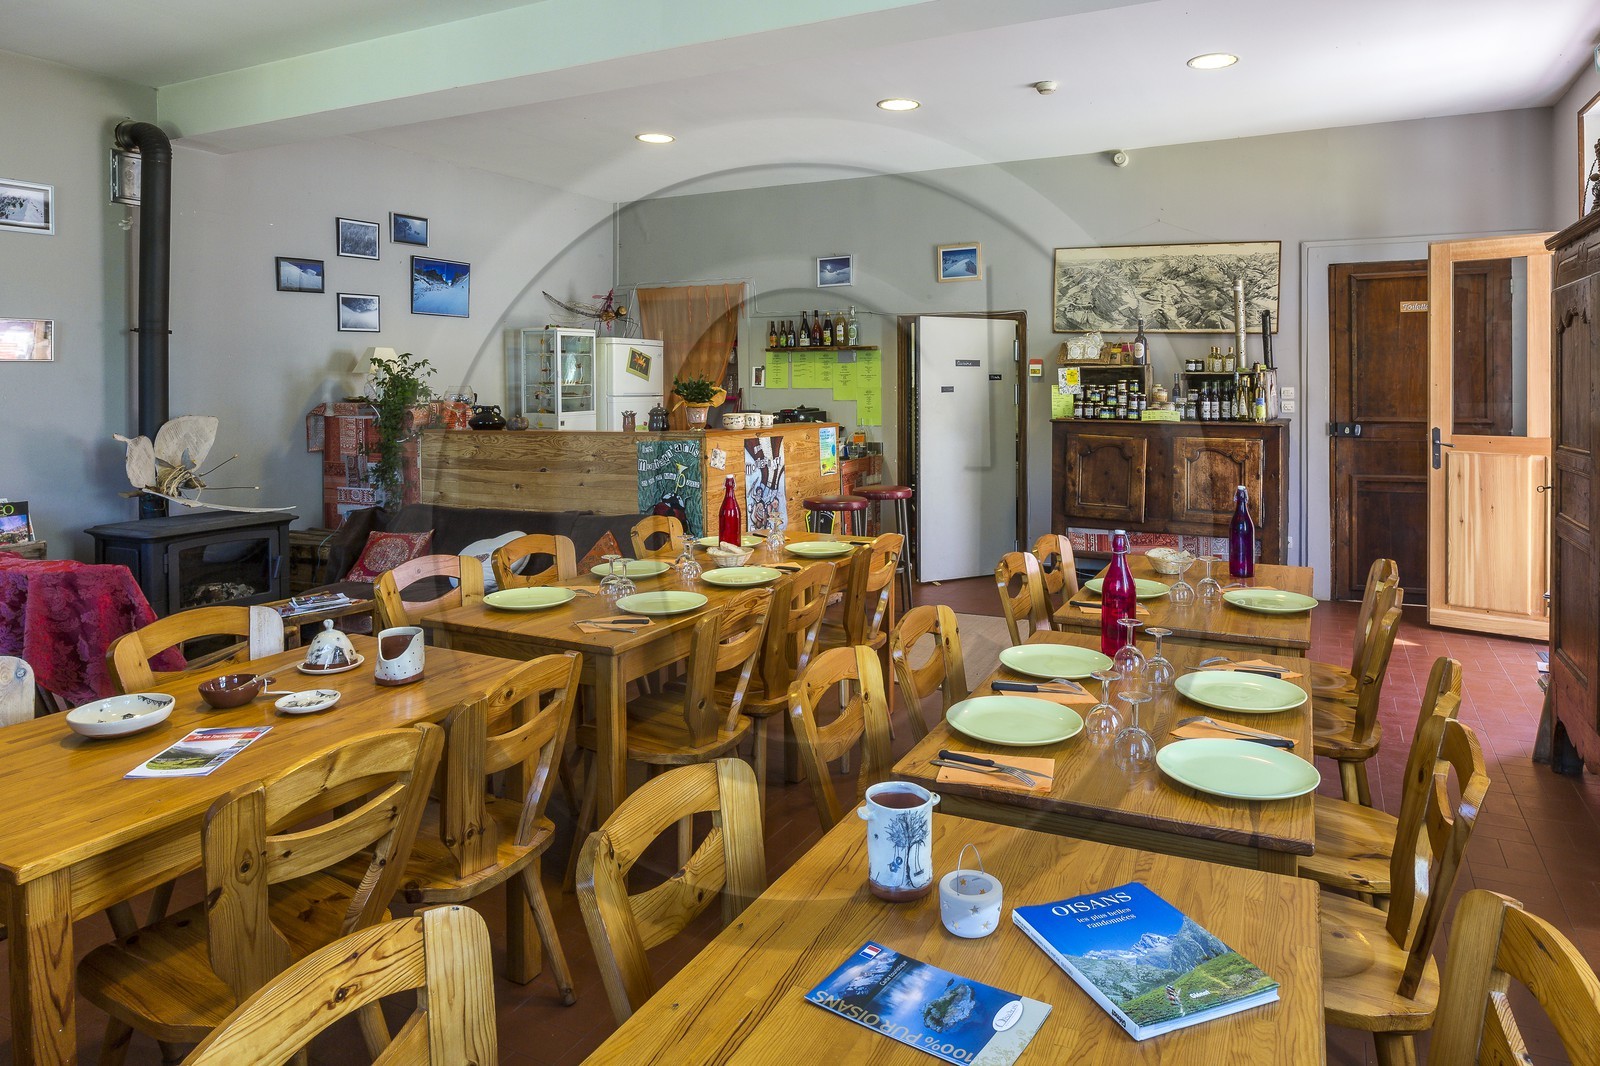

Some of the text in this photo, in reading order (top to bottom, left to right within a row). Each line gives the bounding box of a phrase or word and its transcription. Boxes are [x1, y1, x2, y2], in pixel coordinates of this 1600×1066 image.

[1051, 891, 1132, 917] OISANS
[1086, 914, 1137, 929] randonnées
[1090, 912, 1107, 922] plus
[1107, 907, 1132, 917] belles
[812, 990, 974, 1063] 100% PUR OISANS
